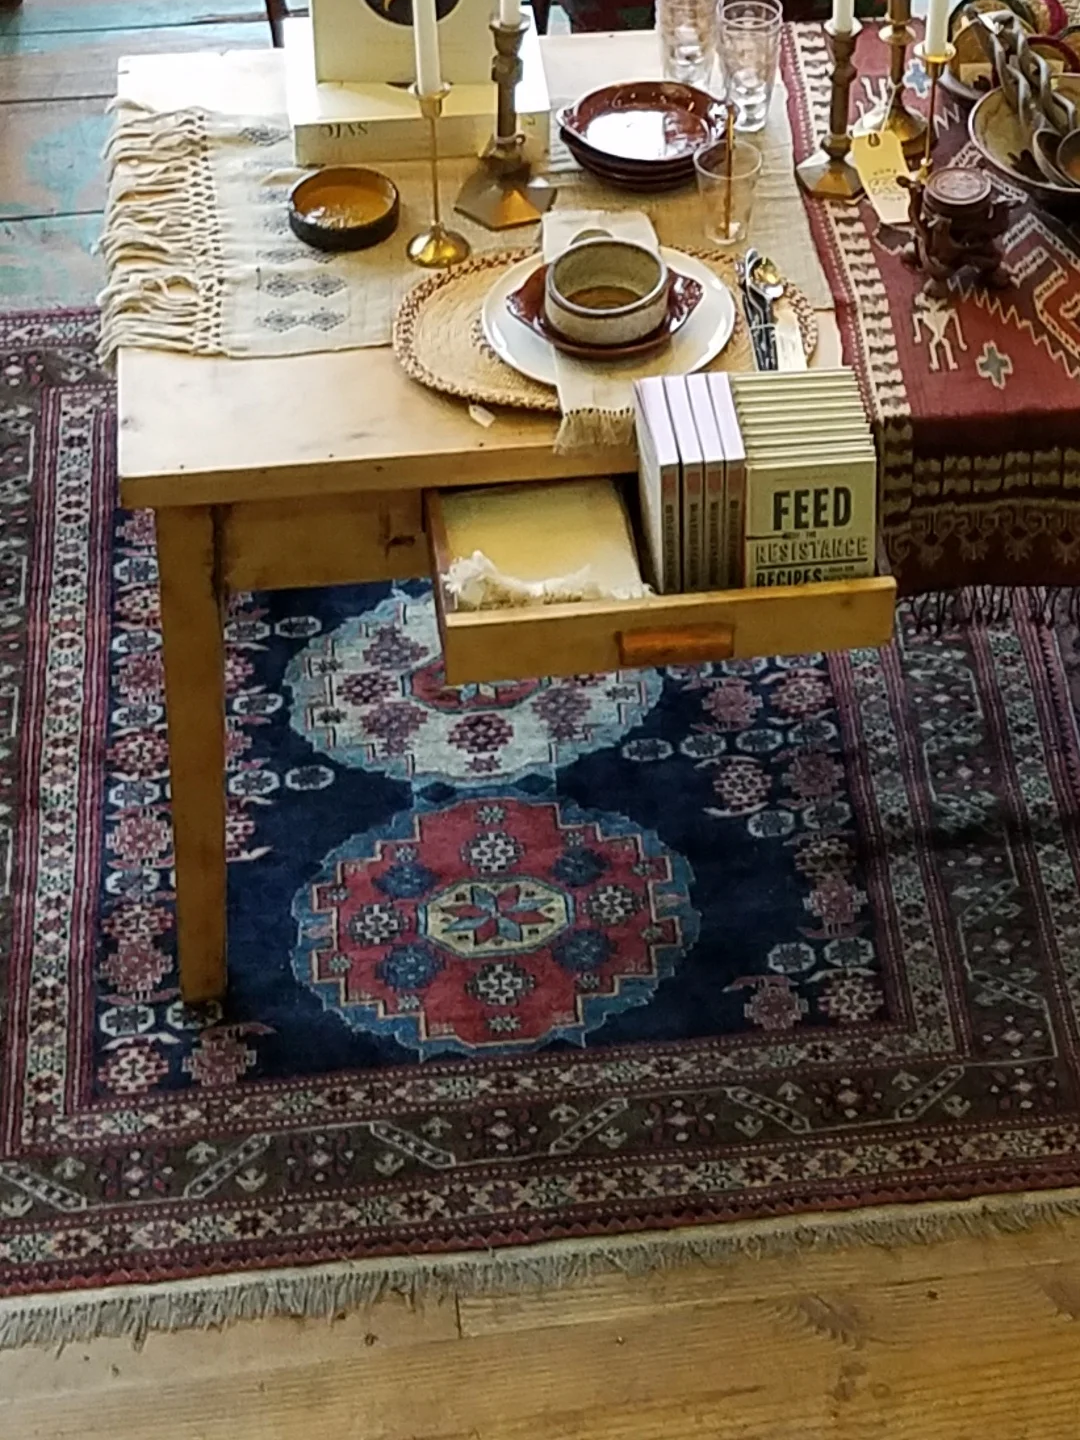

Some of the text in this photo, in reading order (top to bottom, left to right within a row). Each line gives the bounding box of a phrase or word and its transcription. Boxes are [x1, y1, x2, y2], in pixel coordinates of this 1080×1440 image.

[772, 485, 853, 532] FEED
[755, 536, 869, 565] RESISTANCE
[756, 566, 823, 588] RECIPES
